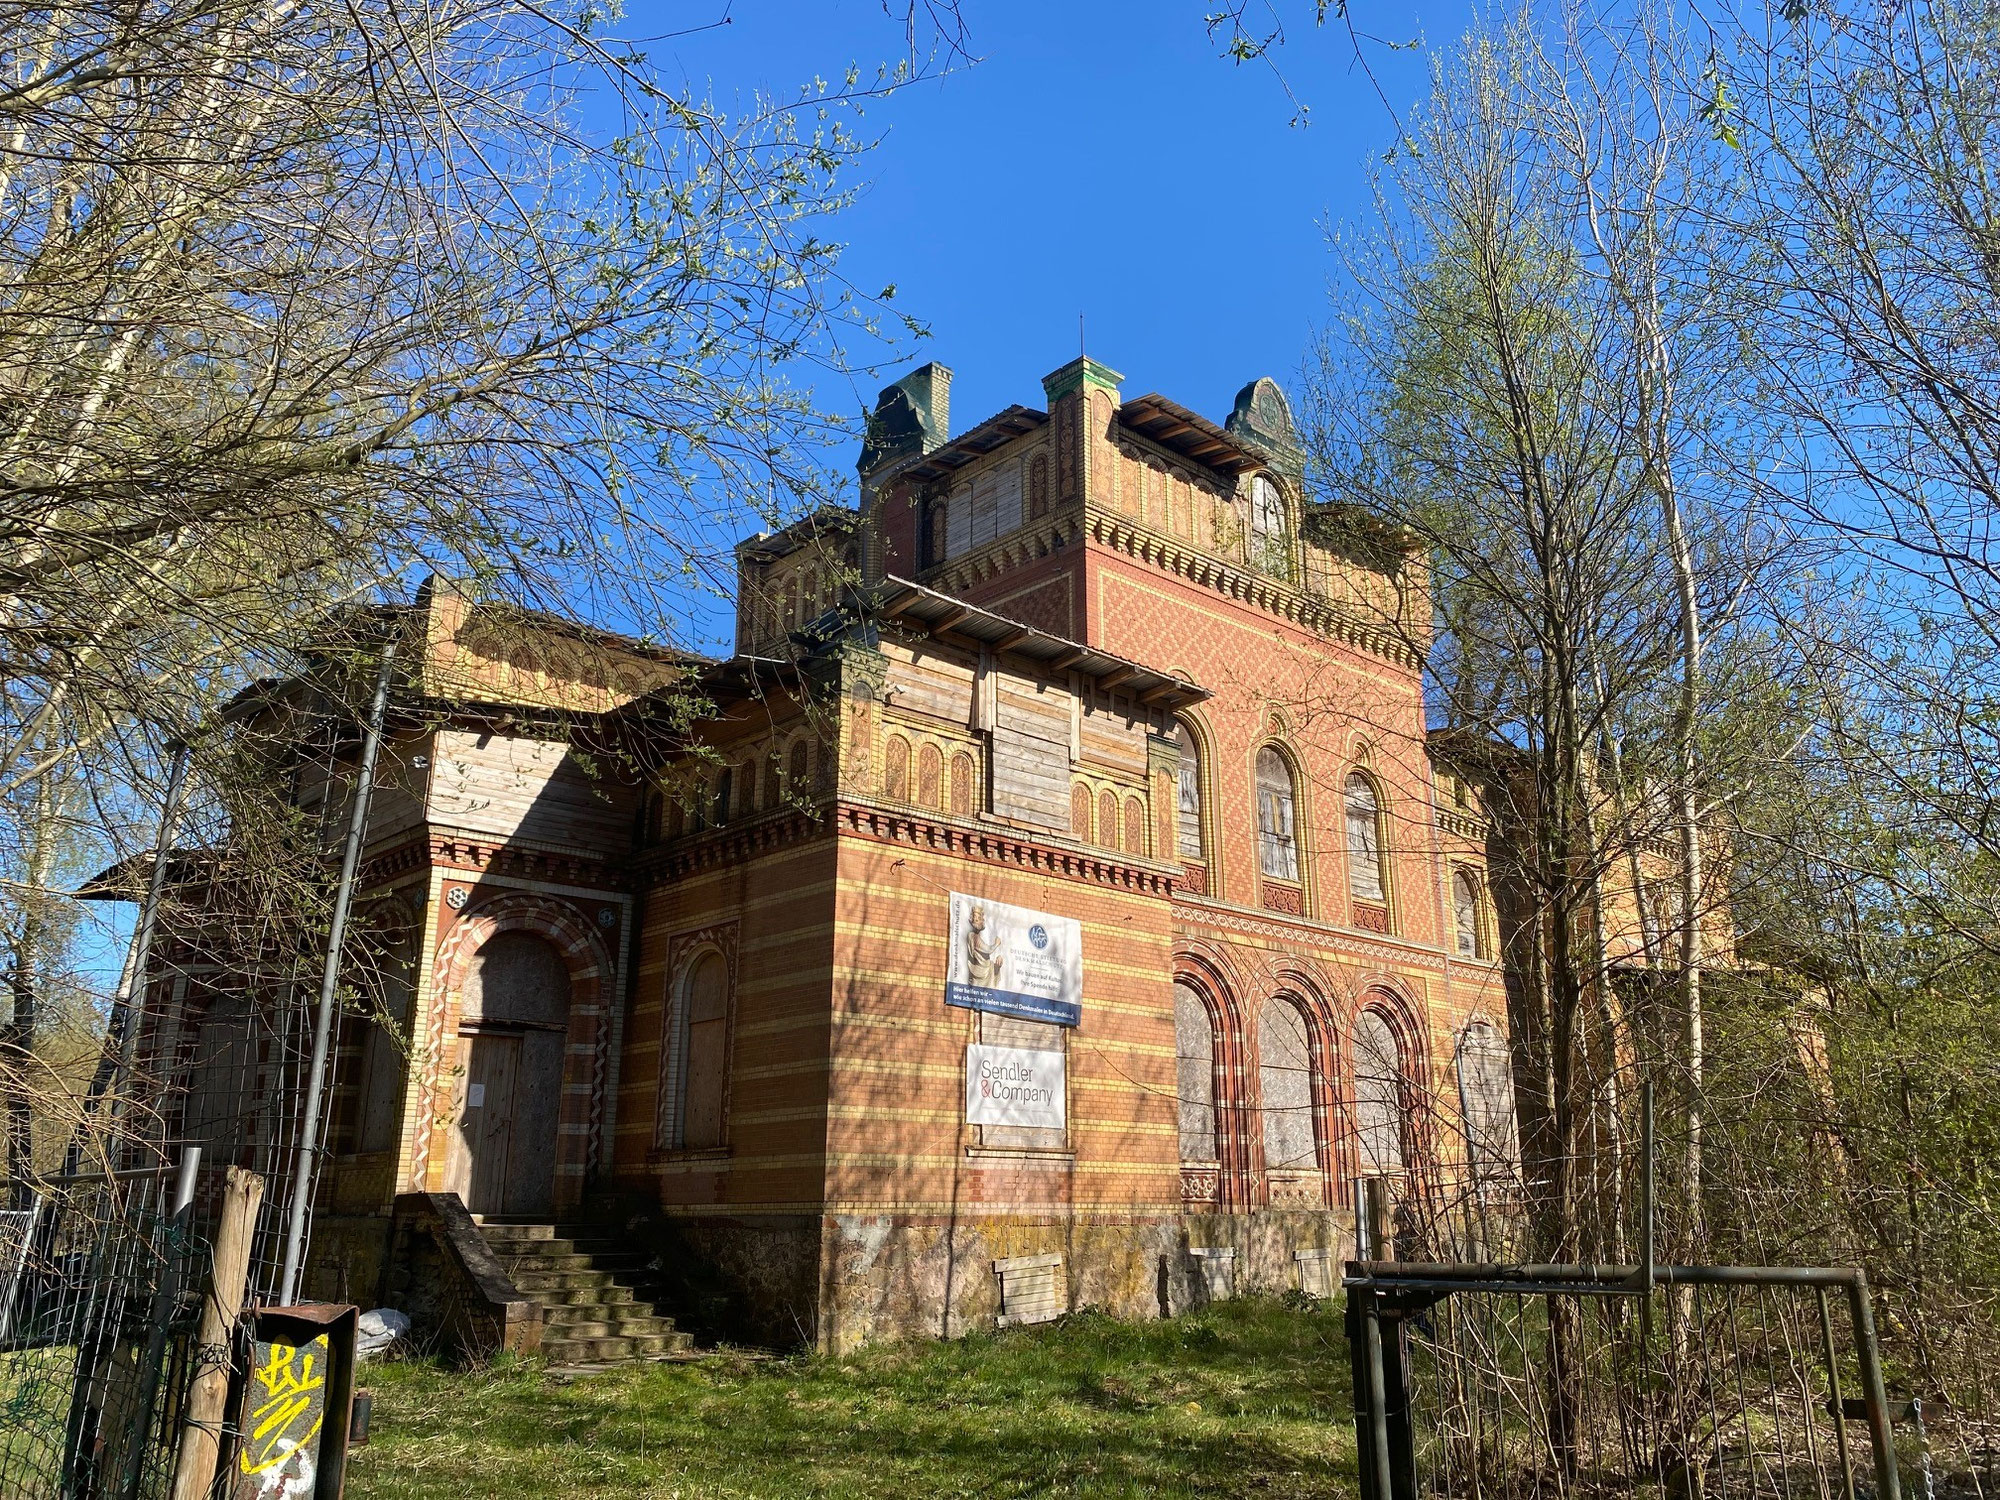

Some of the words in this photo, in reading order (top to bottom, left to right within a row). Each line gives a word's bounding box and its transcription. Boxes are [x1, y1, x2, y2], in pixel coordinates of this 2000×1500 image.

[1025, 970, 1040, 978] bauen
[1040, 973, 1048, 981] auf
[964, 986, 979, 995] helfen
[1030, 981, 1048, 989] Spende
[963, 995, 977, 1003] schon
[984, 998, 999, 1006] vielen
[1000, 1000, 1018, 1010] tausend
[981, 1060, 1033, 1082] Sendler
